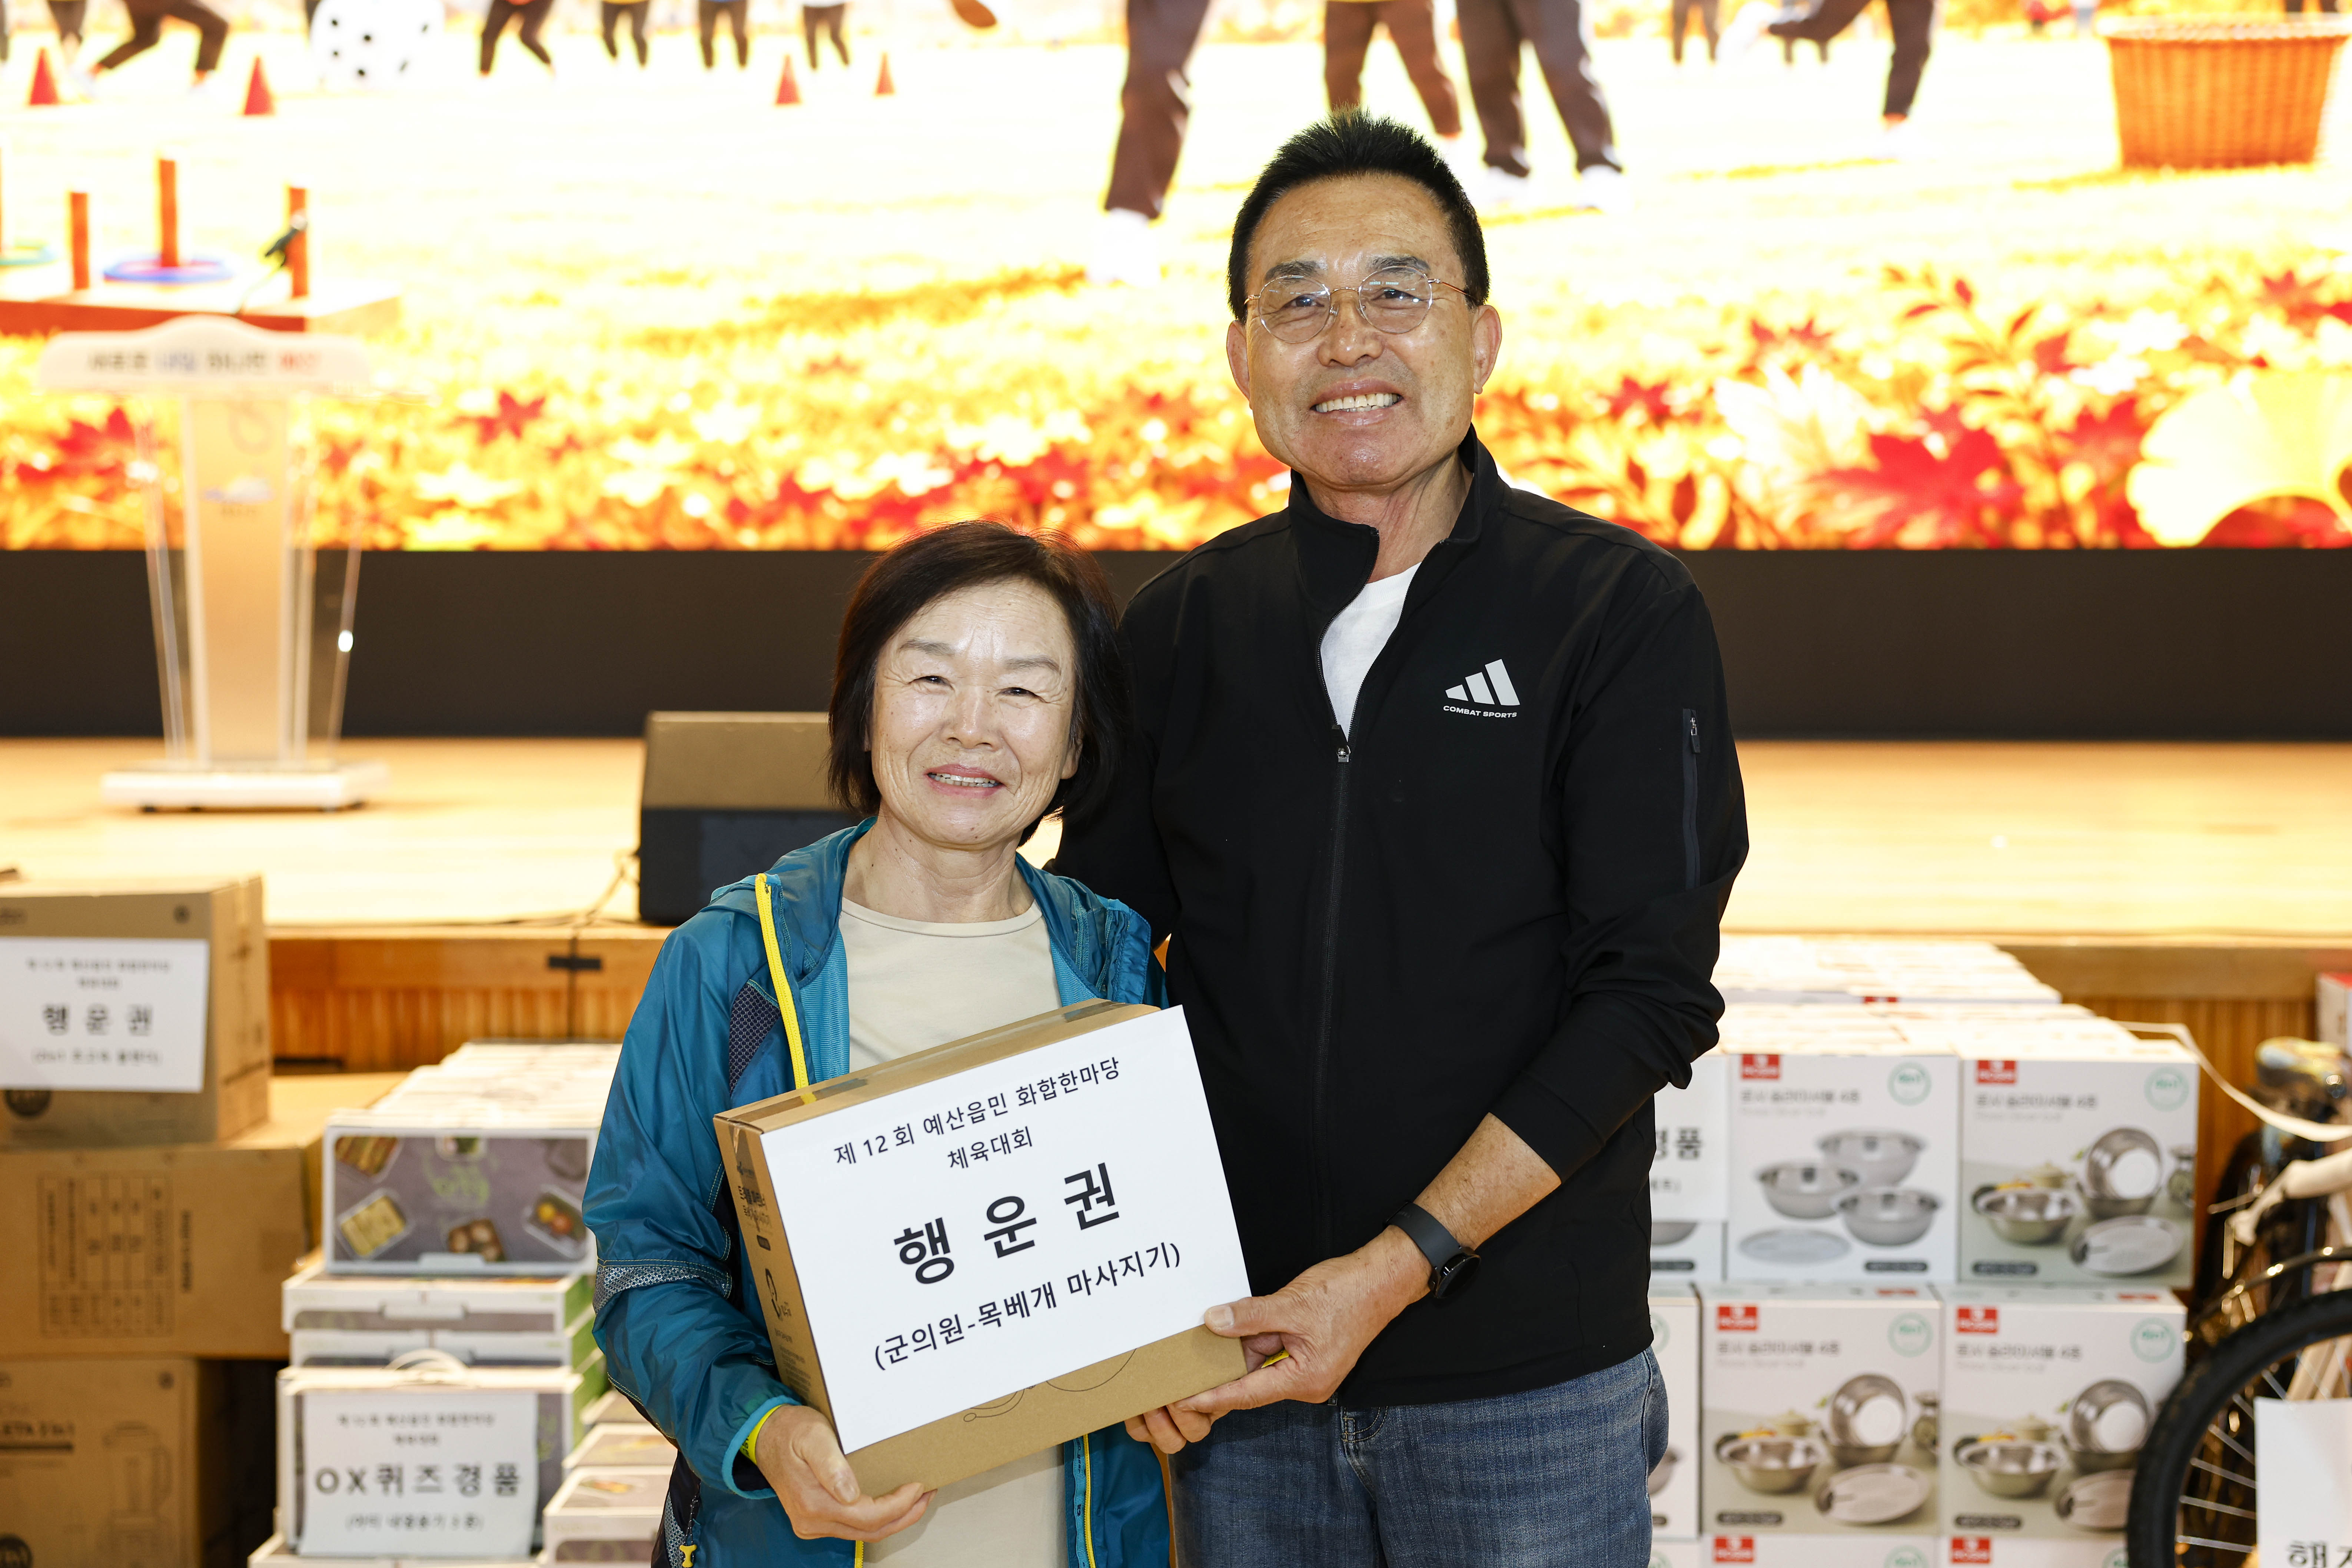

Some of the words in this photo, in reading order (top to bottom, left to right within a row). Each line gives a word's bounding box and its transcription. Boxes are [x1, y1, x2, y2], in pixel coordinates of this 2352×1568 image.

[1443, 705, 1481, 716] COMBAT
[834, 1142, 856, 1164] 제
[863, 1135, 888, 1156] 12
[893, 1123, 914, 1146] 회
[923, 1093, 1009, 1135] 예산읍민
[1016, 1057, 1120, 1106] 화합한마당
[947, 1126, 1033, 1169] 체육대회
[875, 1281, 1057, 1371] (군의원-목베개
[1067, 1242, 1180, 1296] 마사지기)
